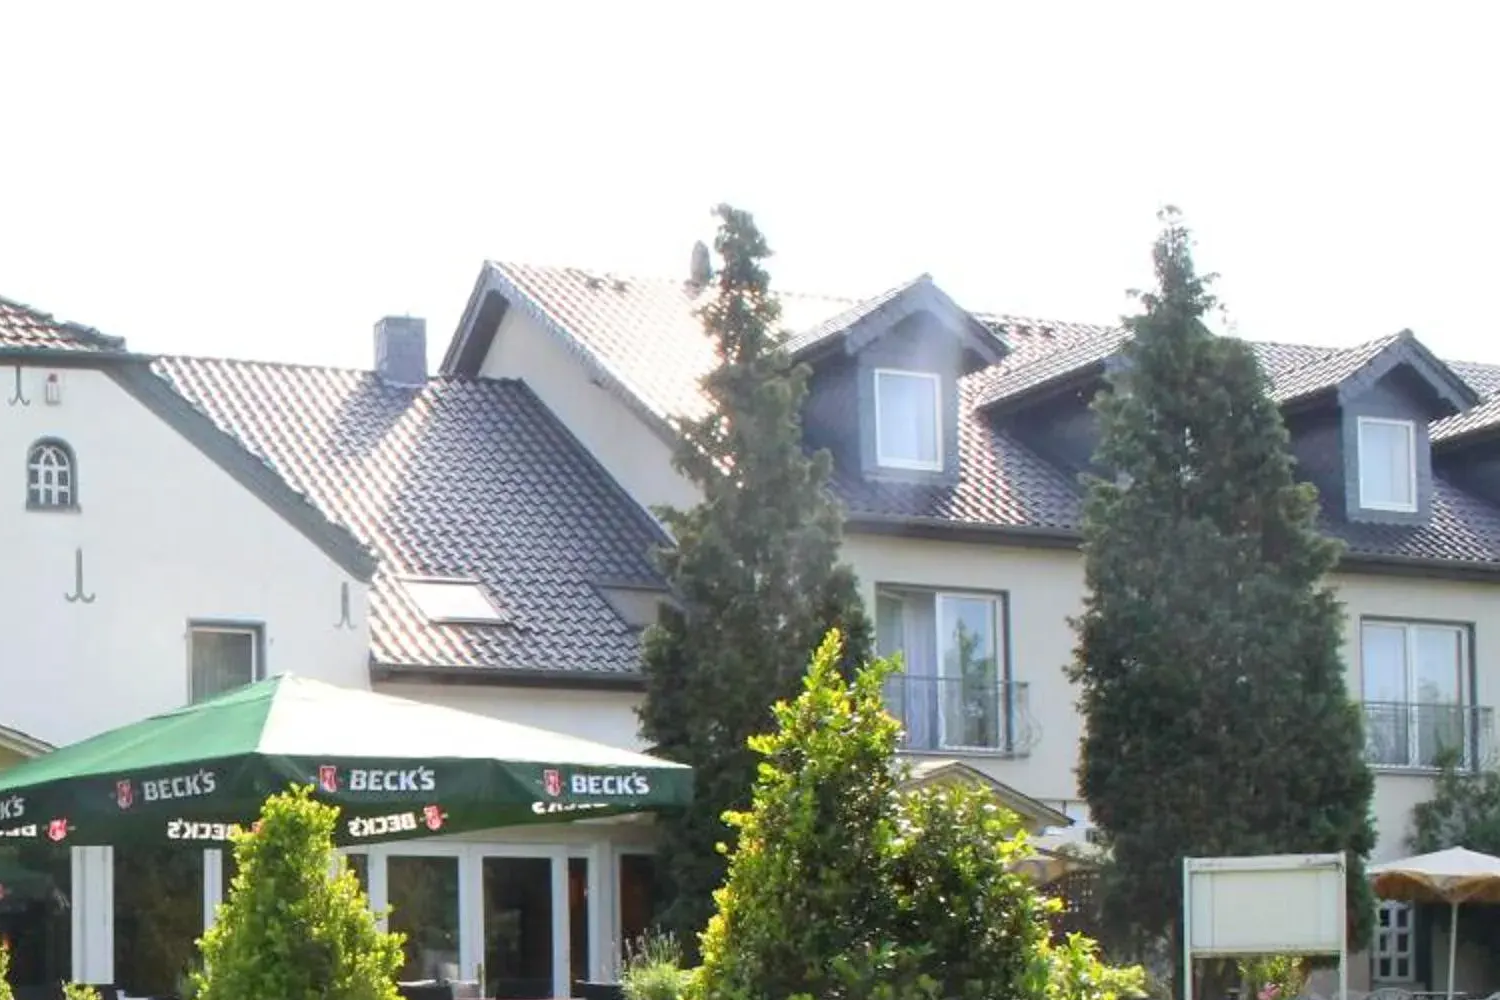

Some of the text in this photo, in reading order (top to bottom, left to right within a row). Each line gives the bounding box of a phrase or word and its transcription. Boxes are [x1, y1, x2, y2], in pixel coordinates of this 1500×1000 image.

[143, 769, 216, 801] BECK'S
[350, 766, 436, 791] BECK'S
[570, 772, 650, 795] BECK'S
